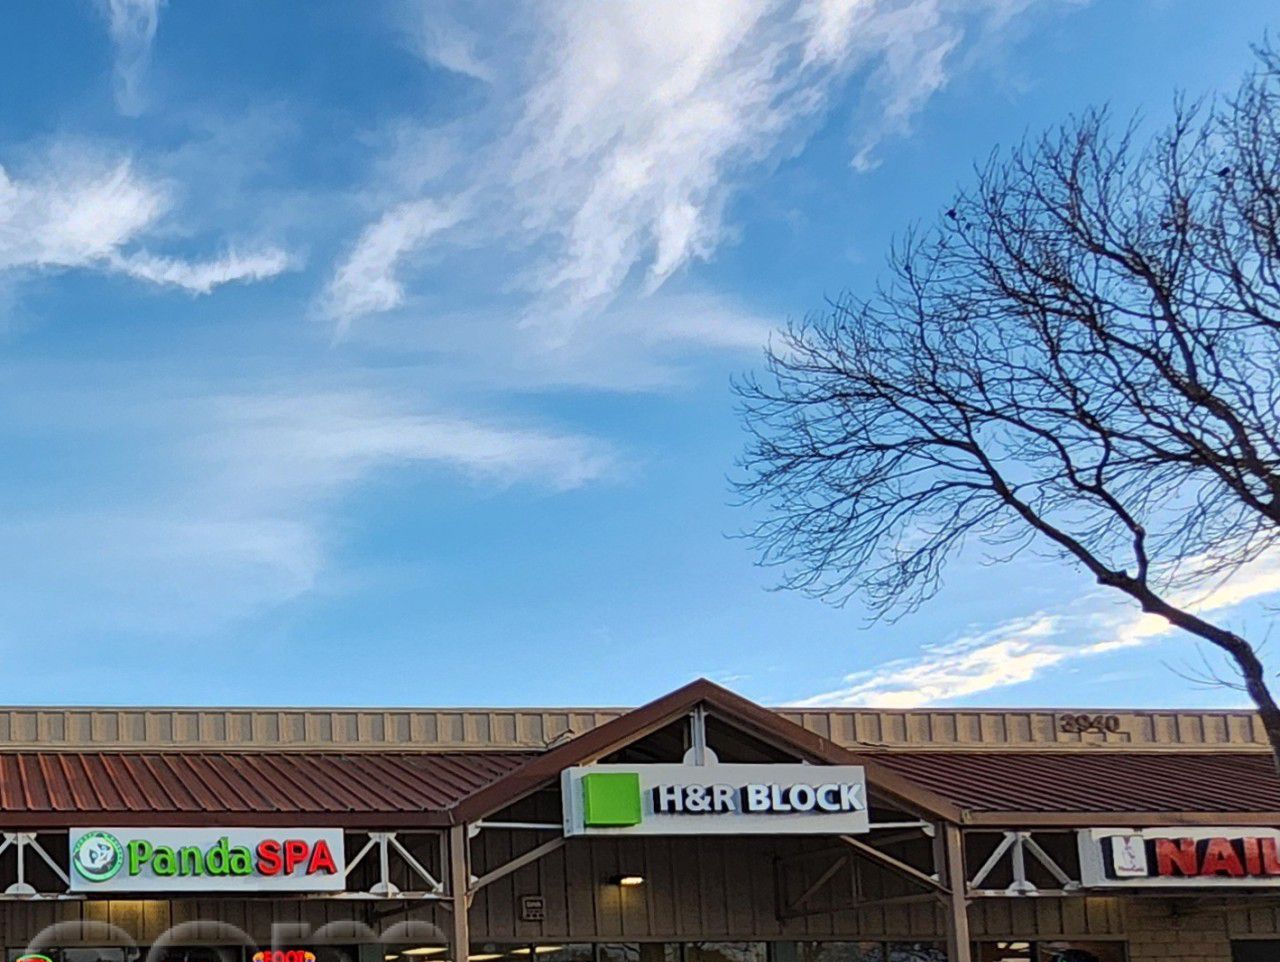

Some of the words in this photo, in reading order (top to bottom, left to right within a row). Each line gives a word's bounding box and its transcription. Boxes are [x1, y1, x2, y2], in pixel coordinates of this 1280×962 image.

[1060, 714, 1121, 733] 3940
[656, 783, 737, 812] H&R
[746, 783, 866, 812] BLOCK
